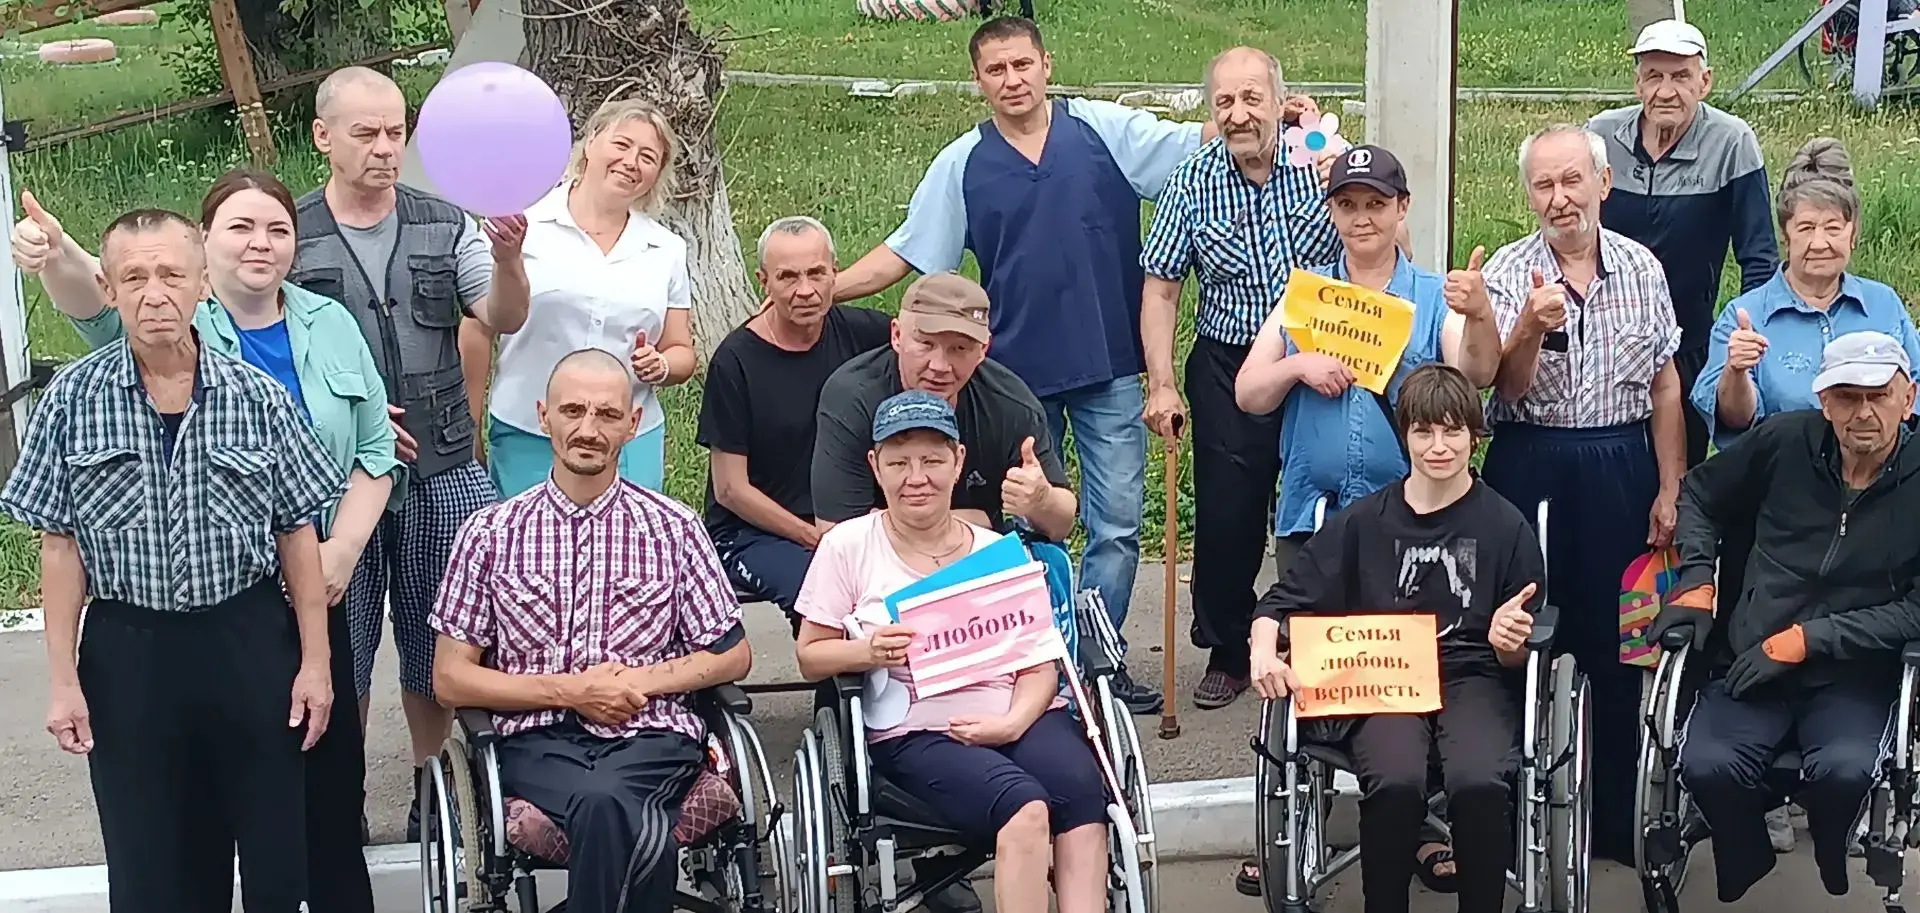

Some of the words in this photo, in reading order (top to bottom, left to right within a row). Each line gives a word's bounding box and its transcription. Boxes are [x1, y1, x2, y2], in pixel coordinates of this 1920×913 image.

[1318, 286, 1383, 319] Семья
[1306, 316, 1383, 347] любовь
[924, 610, 1036, 653] любовь
[1325, 625, 1401, 644] Семья
[1321, 651, 1410, 671] любовь
[1314, 683, 1421, 705] верность
